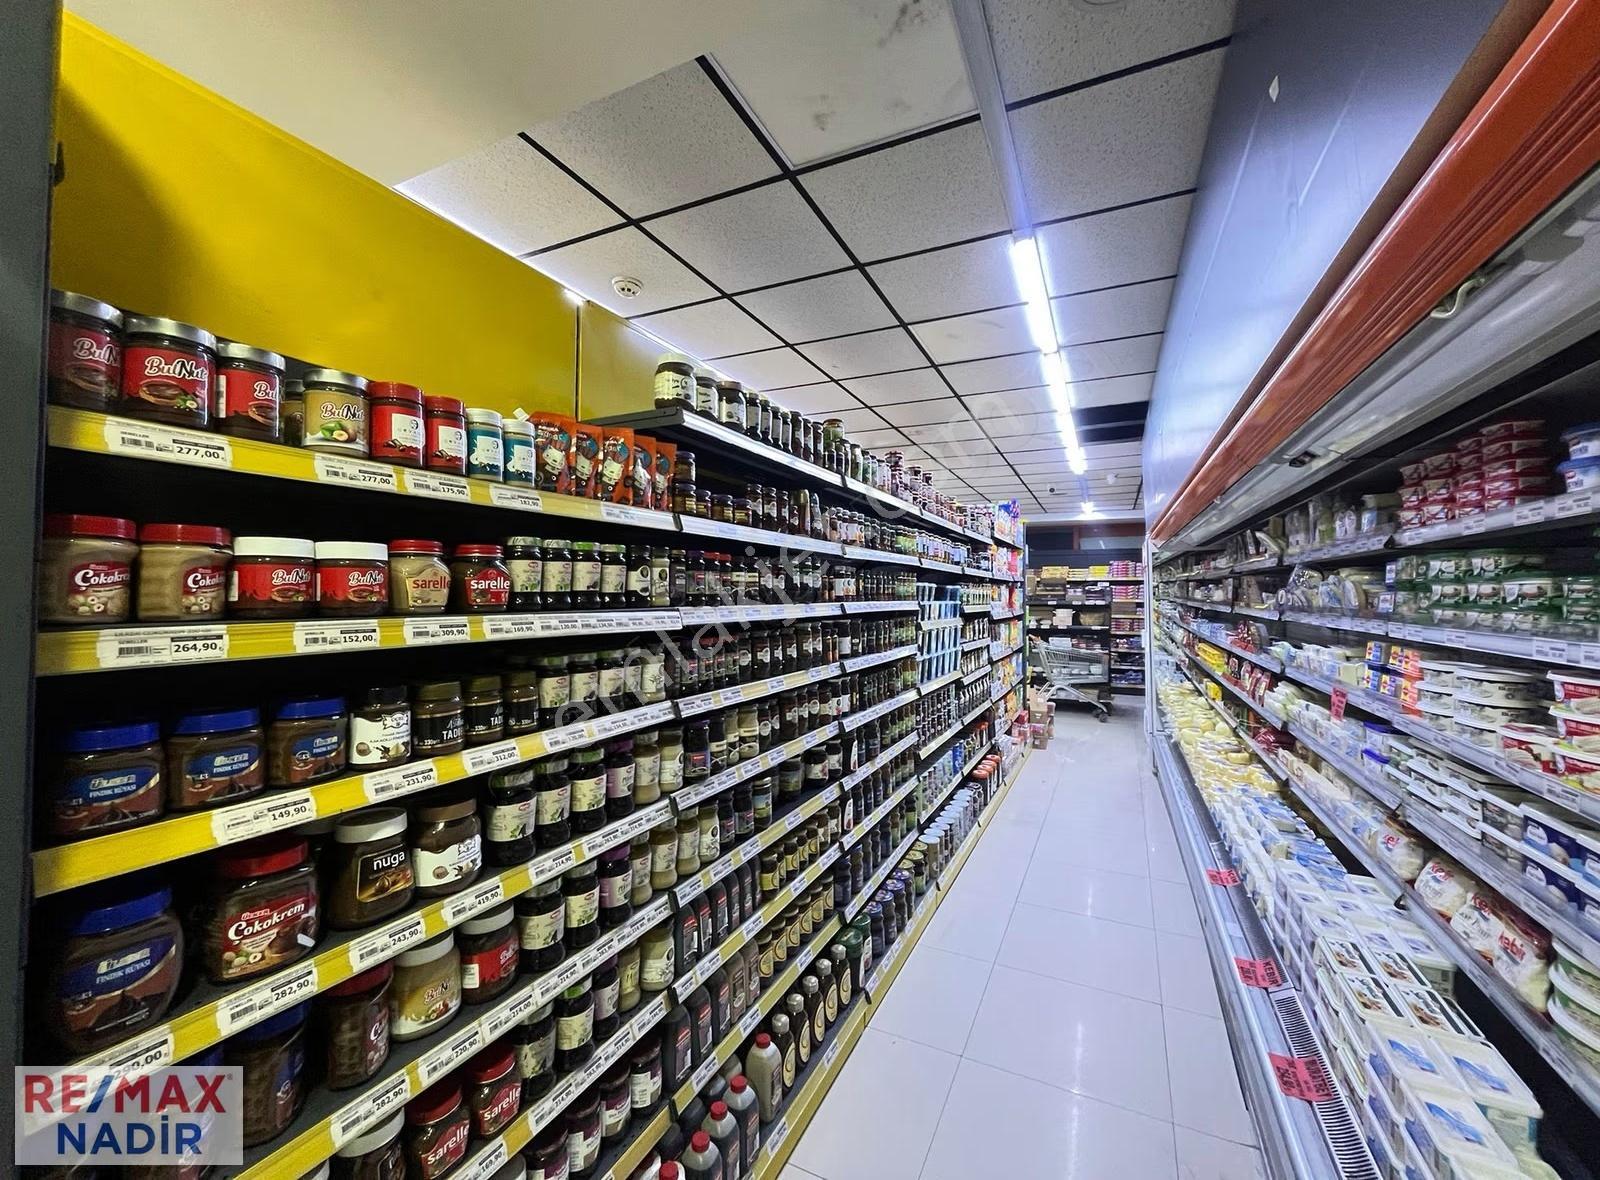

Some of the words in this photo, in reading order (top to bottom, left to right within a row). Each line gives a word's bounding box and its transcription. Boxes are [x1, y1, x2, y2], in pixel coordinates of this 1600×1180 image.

[177, 446, 220, 459] 277,00
[361, 475, 391, 485] 277,00
[470, 577, 510, 590] sarelle
[343, 634, 374, 643] 152,00
[441, 628, 465, 637] 309,90
[174, 642, 217, 653] 264,90
[406, 774, 432, 786] 231,90
[271, 805, 307, 821] 149,90
[373, 851, 404, 870] nuga
[228, 903, 305, 945] Çokokrem
[273, 979, 310, 1001] 282,90
[375, 1087, 404, 1111] 282,90
